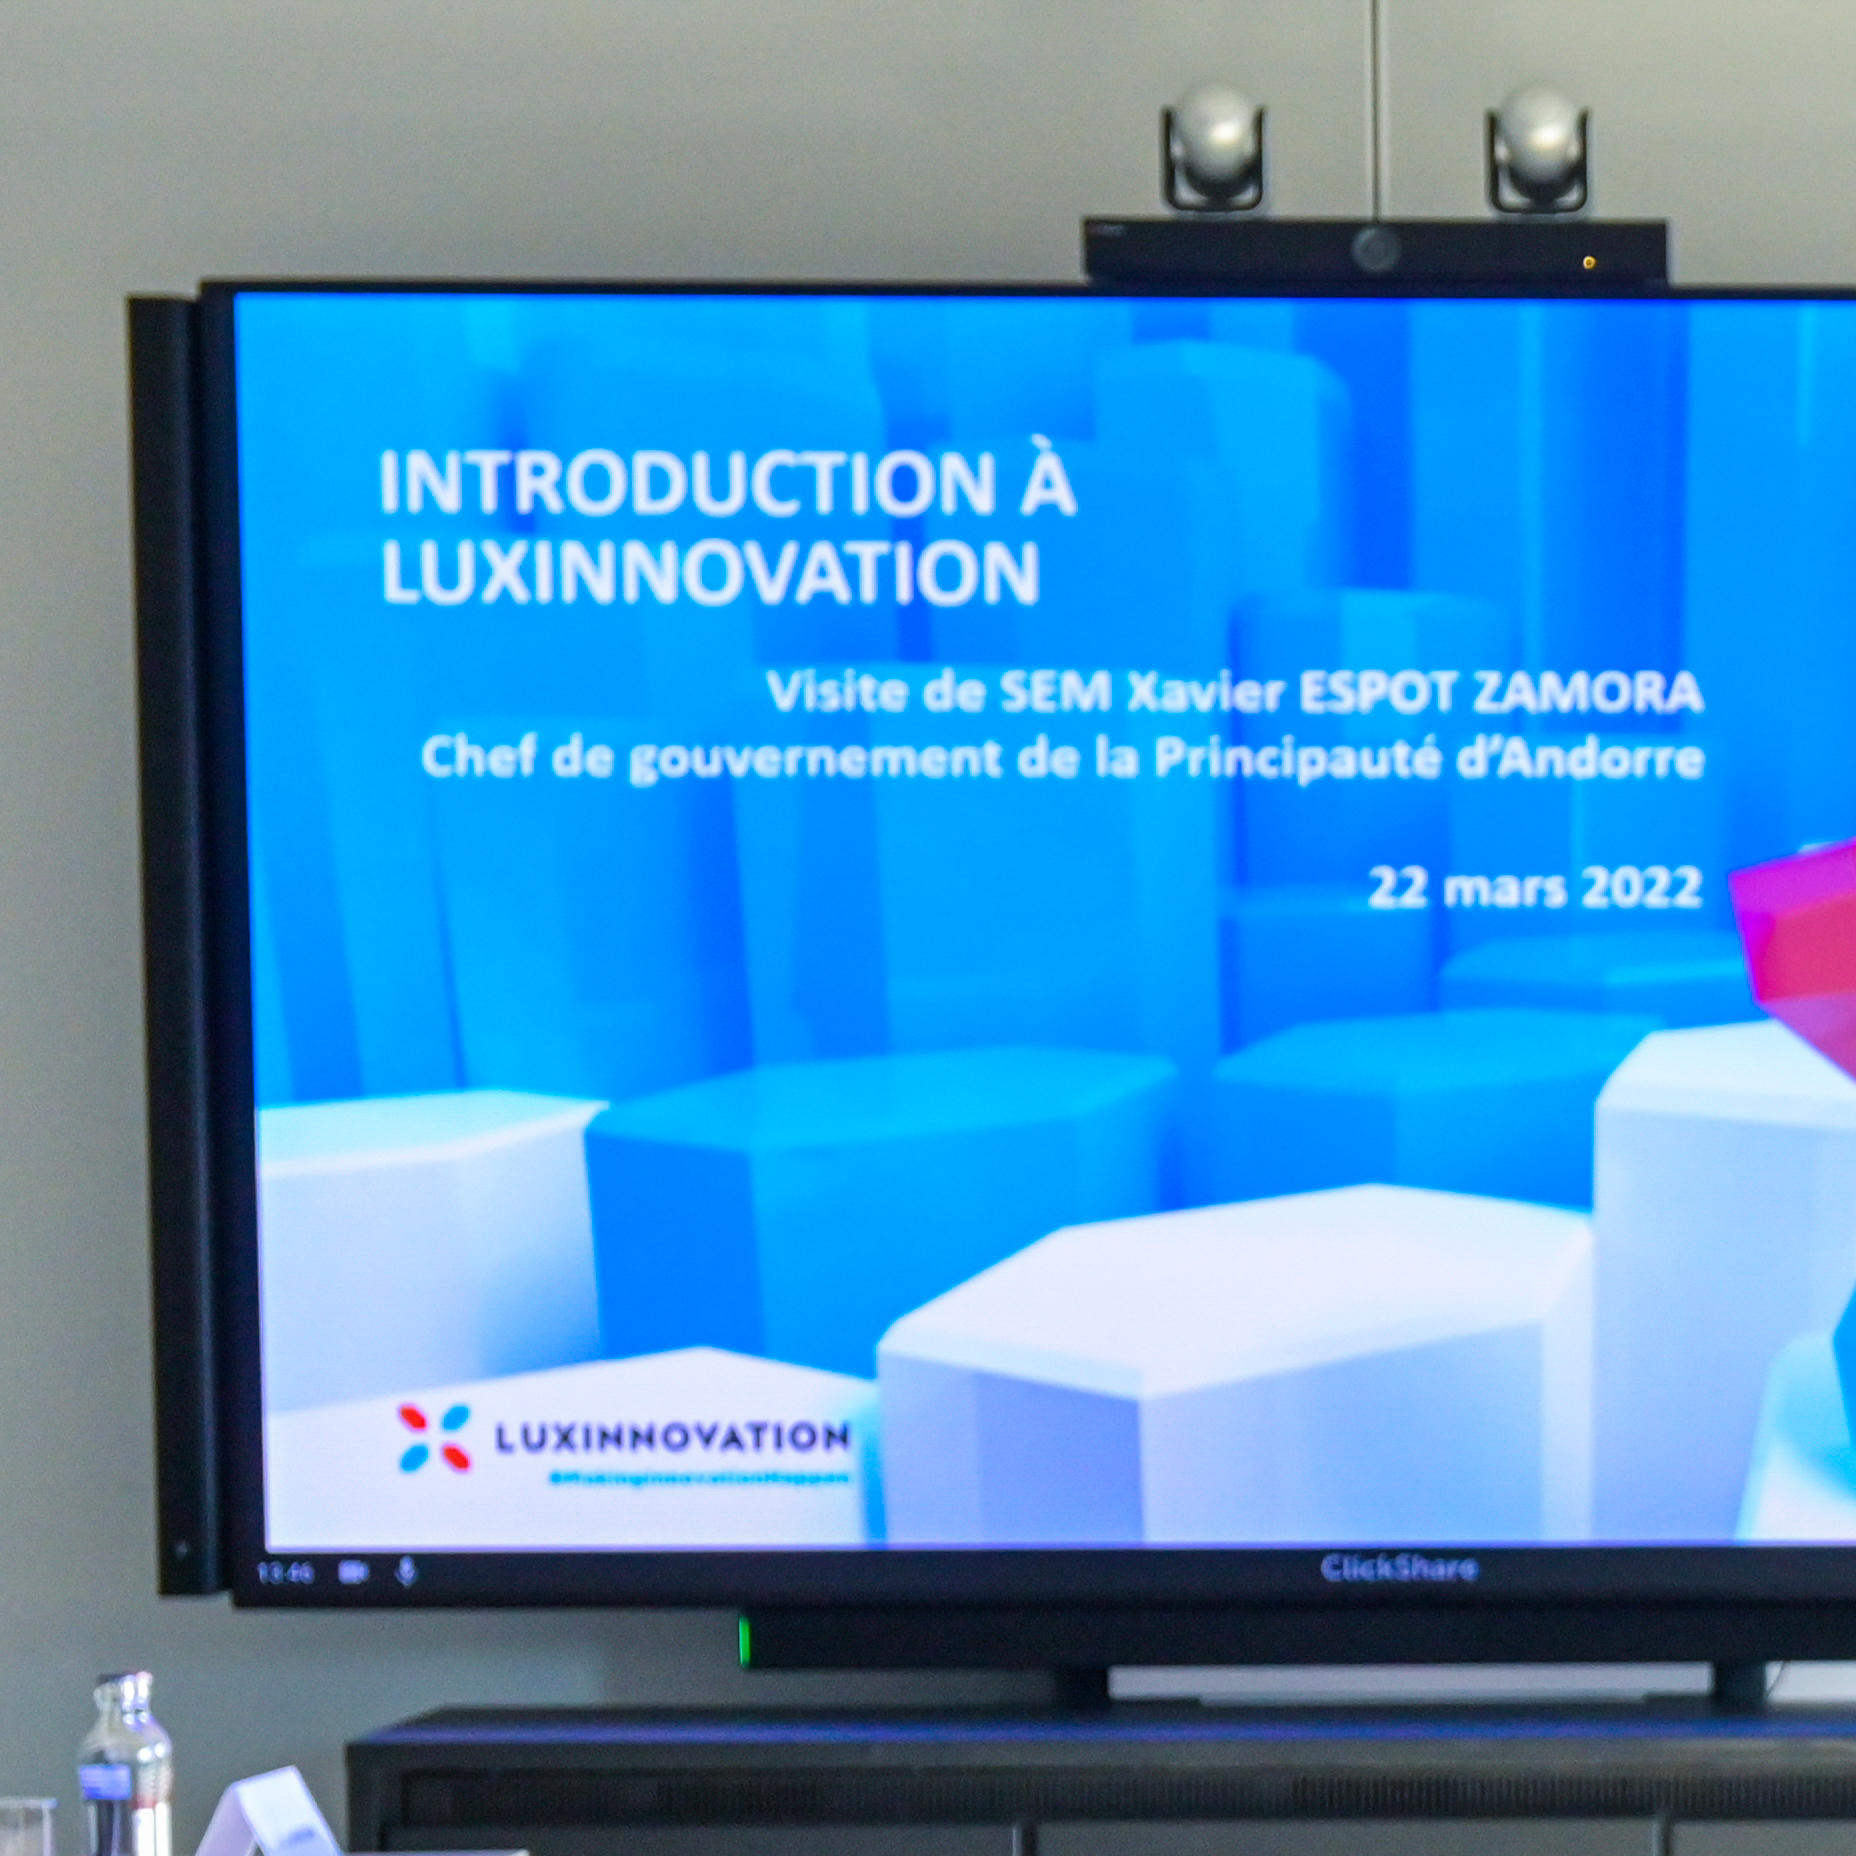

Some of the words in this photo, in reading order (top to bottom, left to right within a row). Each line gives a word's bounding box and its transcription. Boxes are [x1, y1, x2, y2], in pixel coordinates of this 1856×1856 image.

[381, 447, 996, 517] INTRODUCTION
[1020, 433, 1078, 516] À
[382, 538, 1040, 607] LUXINNOVATION
[766, 669, 909, 713] Visite
[922, 668, 988, 713] de
[1000, 669, 1112, 713] SEM
[1128, 669, 1286, 713] Xavier
[1300, 669, 1459, 715] ESPOT
[1472, 670, 1705, 714] ZAMORA
[421, 733, 538, 778] Chef
[552, 733, 615, 778] de
[628, 741, 1002, 787] gouvernement
[1016, 734, 1082, 779] de
[1095, 734, 1140, 778] la
[1154, 733, 1444, 787] Principauté
[1368, 865, 1429, 909] 22
[1444, 874, 1568, 909] mars
[1581, 865, 1704, 909] 2022
[495, 1421, 853, 1455] LUXINNOVATION
